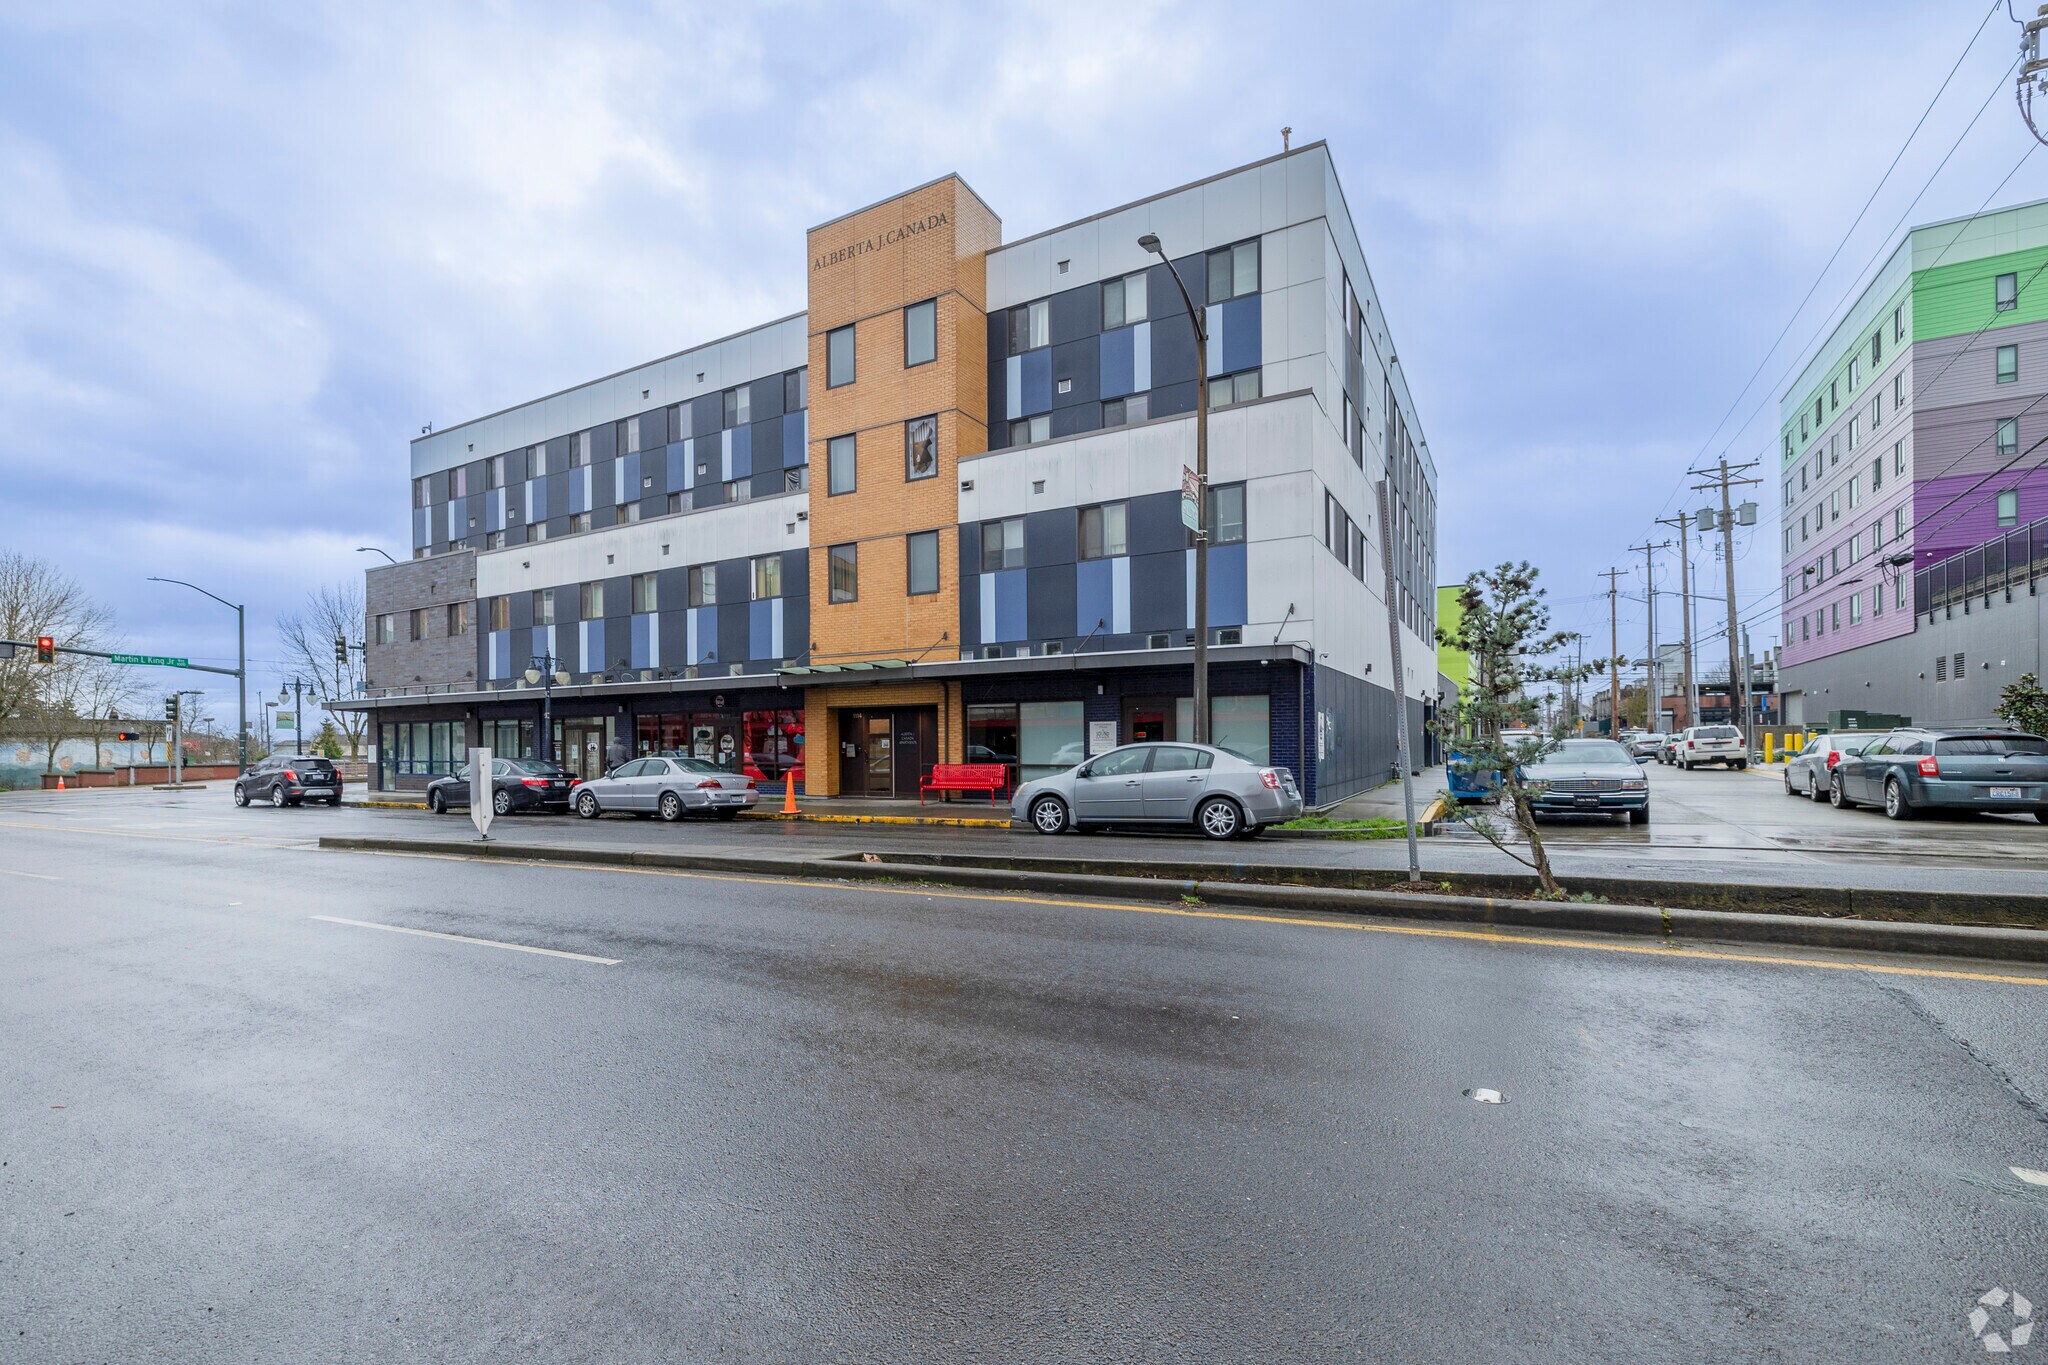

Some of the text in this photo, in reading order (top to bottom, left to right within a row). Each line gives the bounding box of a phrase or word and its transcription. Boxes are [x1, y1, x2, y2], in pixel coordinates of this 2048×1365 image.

[813, 239, 873, 271] ALBERTA
[886, 212, 948, 244] CANADA
[114, 655, 138, 663] Martin
[148, 657, 164, 665] King
